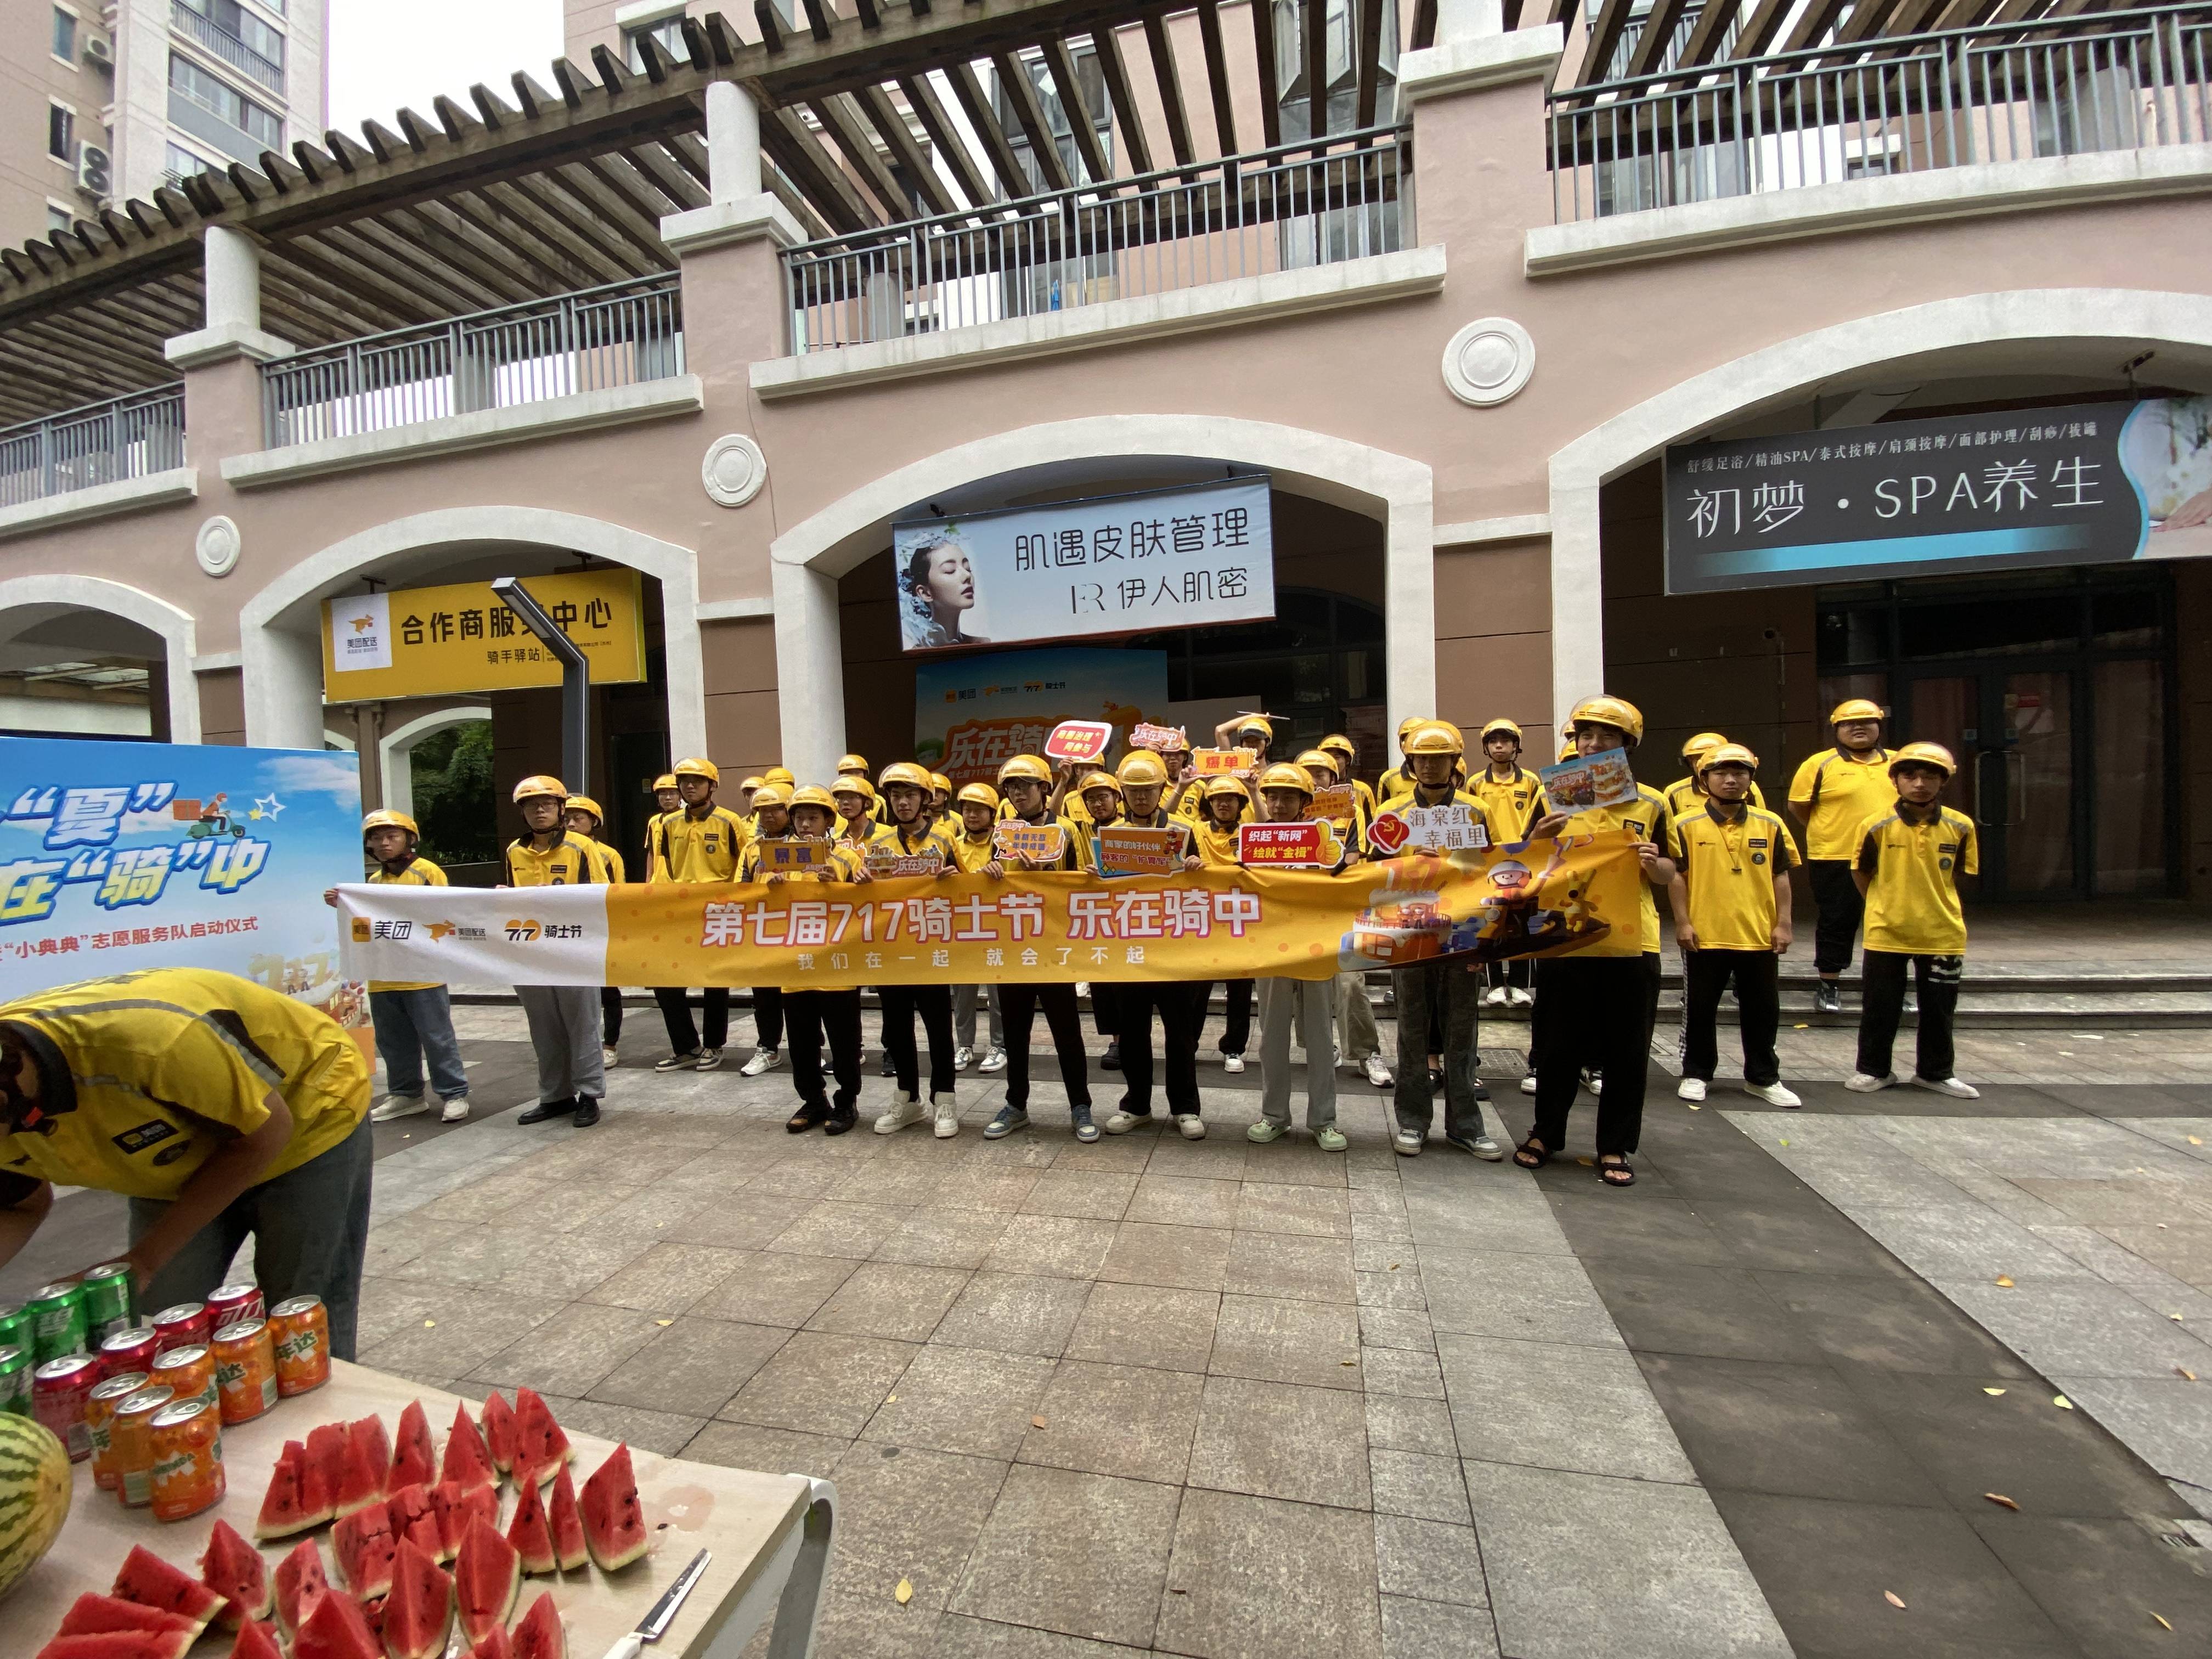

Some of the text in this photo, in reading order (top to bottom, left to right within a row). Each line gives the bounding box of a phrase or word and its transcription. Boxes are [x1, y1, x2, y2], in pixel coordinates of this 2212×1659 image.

[1015, 507, 1250, 572] 肌遇皮肤管理
[1116, 567, 1248, 610] 伊人肌密
[401, 597, 612, 645] 合作商服中心
[487, 647, 540, 665] 骑手驿站
[936, 724, 1062, 774] 乐在骑
[1409, 807, 1469, 827] 海棠红
[1425, 827, 1485, 848] 幸福里
[701, 887, 1261, 947] 第七届717骑士节 乐在骑中
[374, 920, 412, 940] 美团
[544, 924, 582, 939] 骑士节
[797, 945, 1145, 970] 我们在一起 就会了不起
